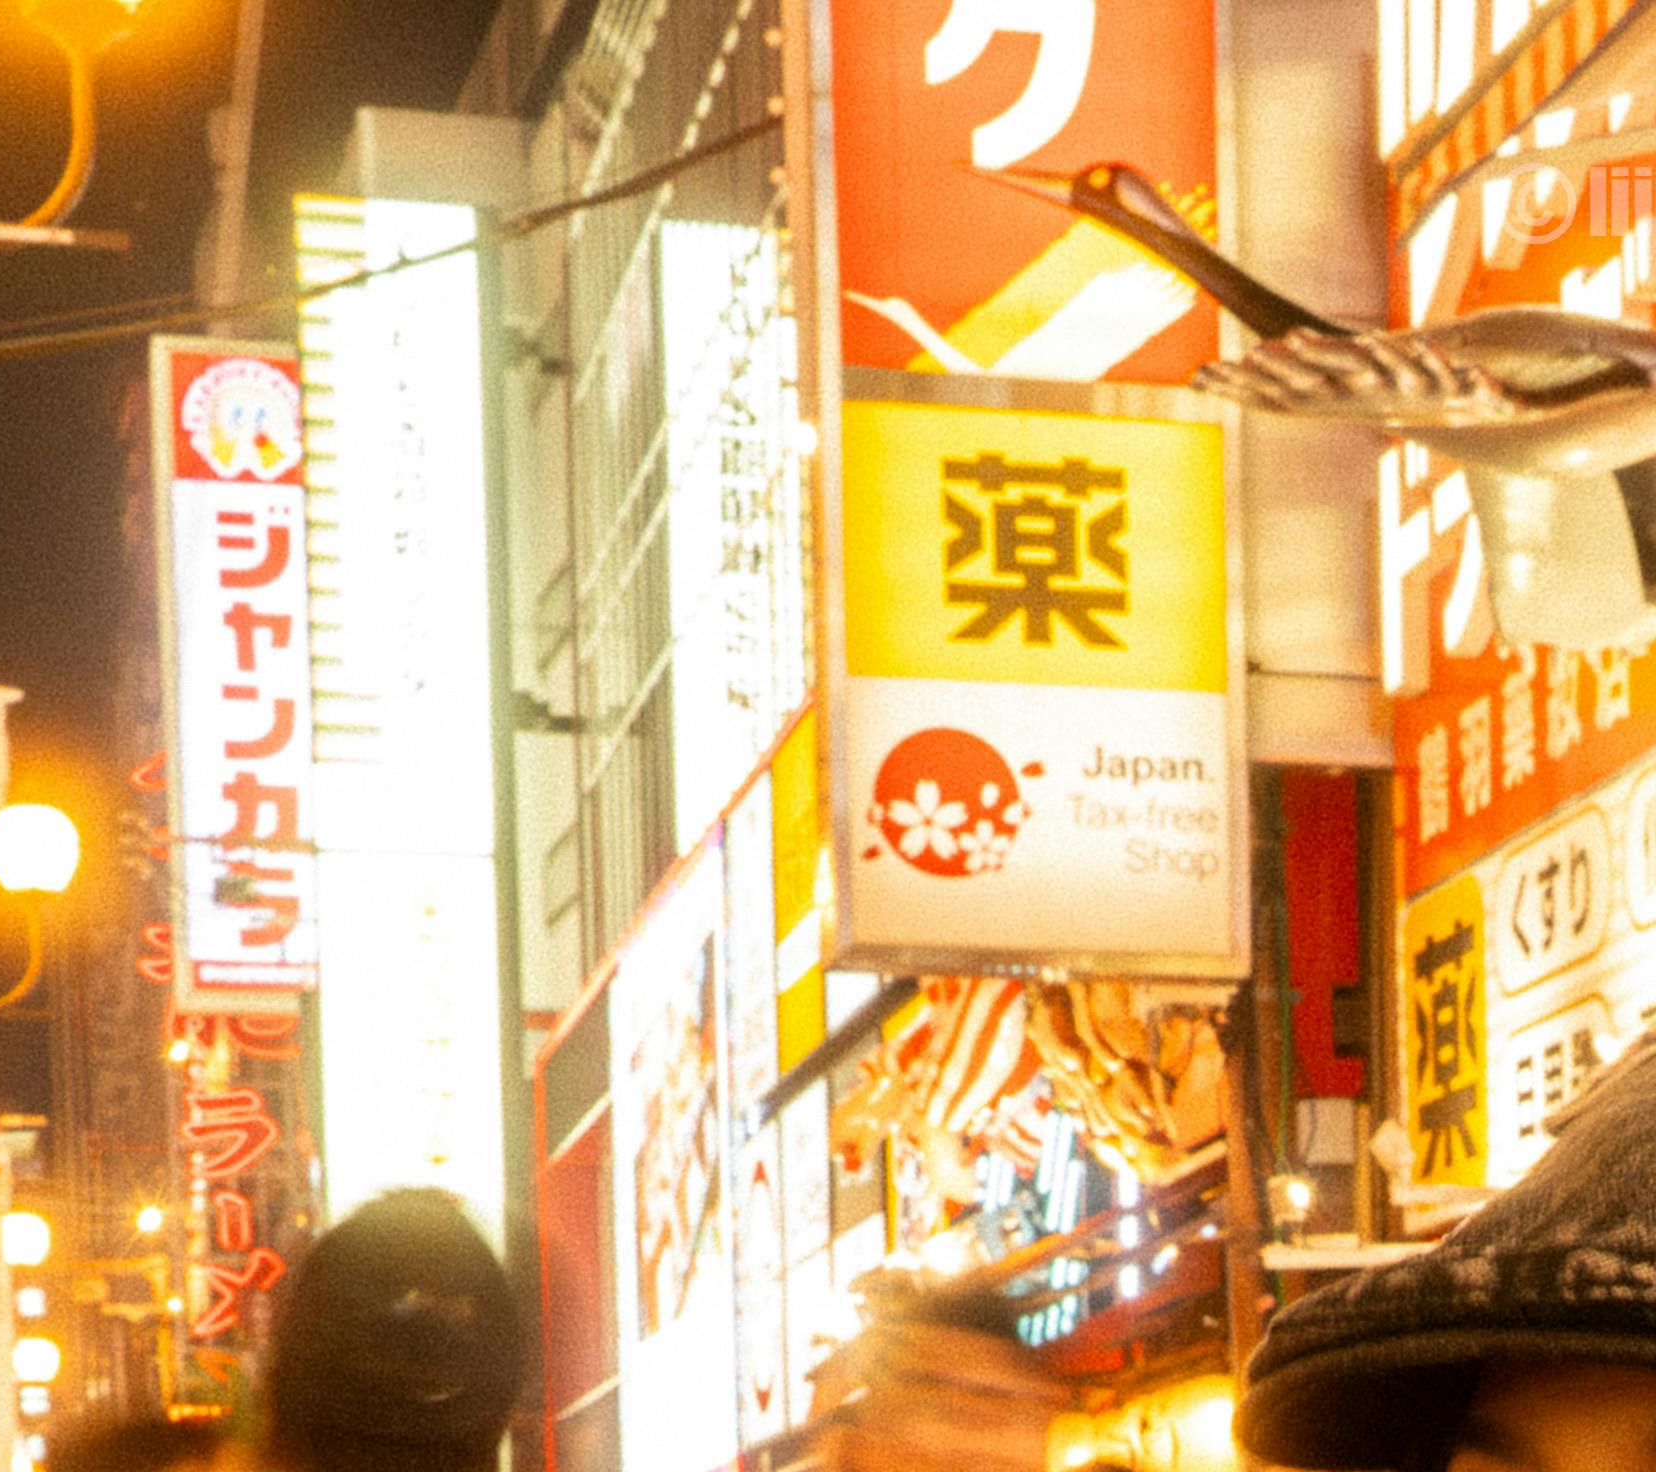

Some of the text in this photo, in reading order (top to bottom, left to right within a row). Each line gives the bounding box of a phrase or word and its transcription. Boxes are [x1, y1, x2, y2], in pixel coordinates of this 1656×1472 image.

[940, 450, 1131, 651] 薬
[1067, 793, 1220, 835] Tax-free
[1121, 838, 1221, 882] Shop
[1507, 843, 1591, 953] くすり
